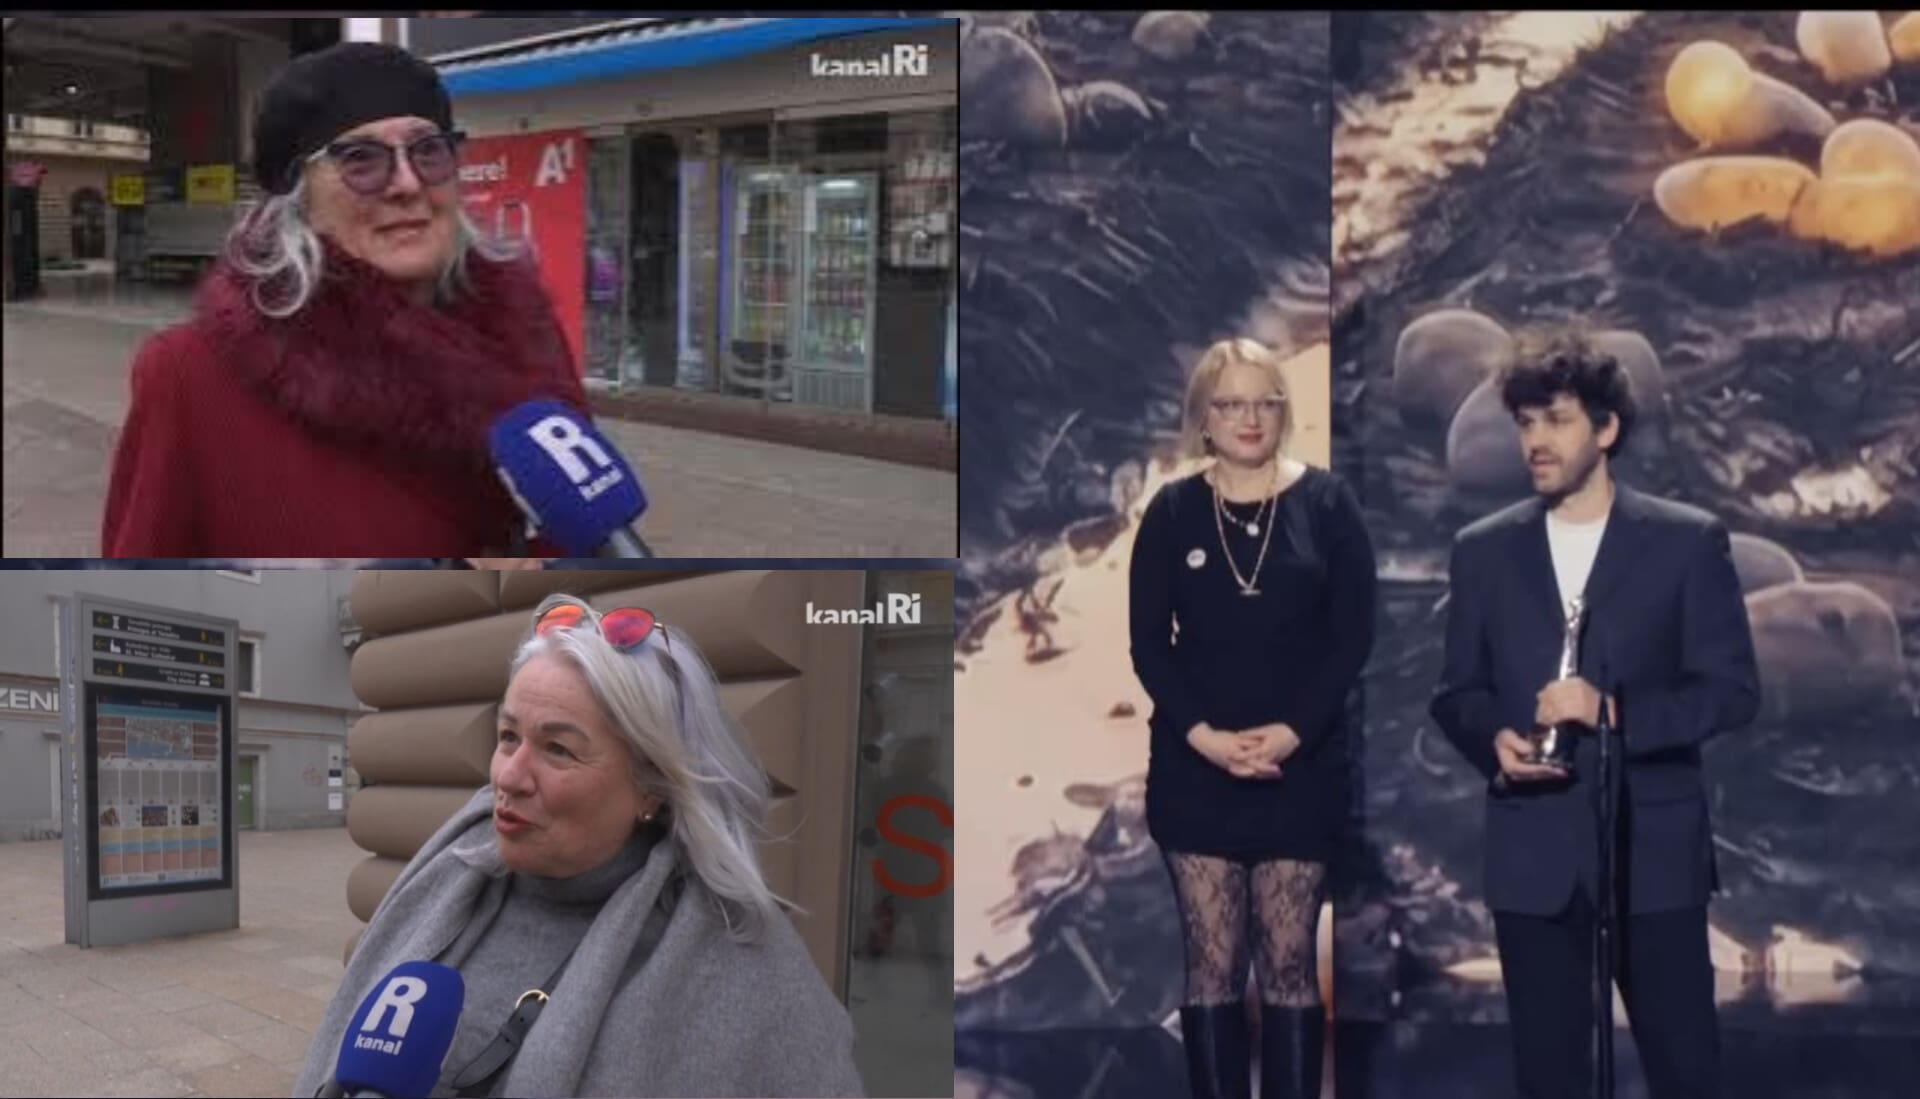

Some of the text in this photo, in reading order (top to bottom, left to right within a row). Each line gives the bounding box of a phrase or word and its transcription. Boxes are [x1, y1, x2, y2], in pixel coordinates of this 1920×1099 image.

[528, 416, 612, 484] R
[360, 976, 427, 1038] R
[354, 1033, 403, 1056] kanal
